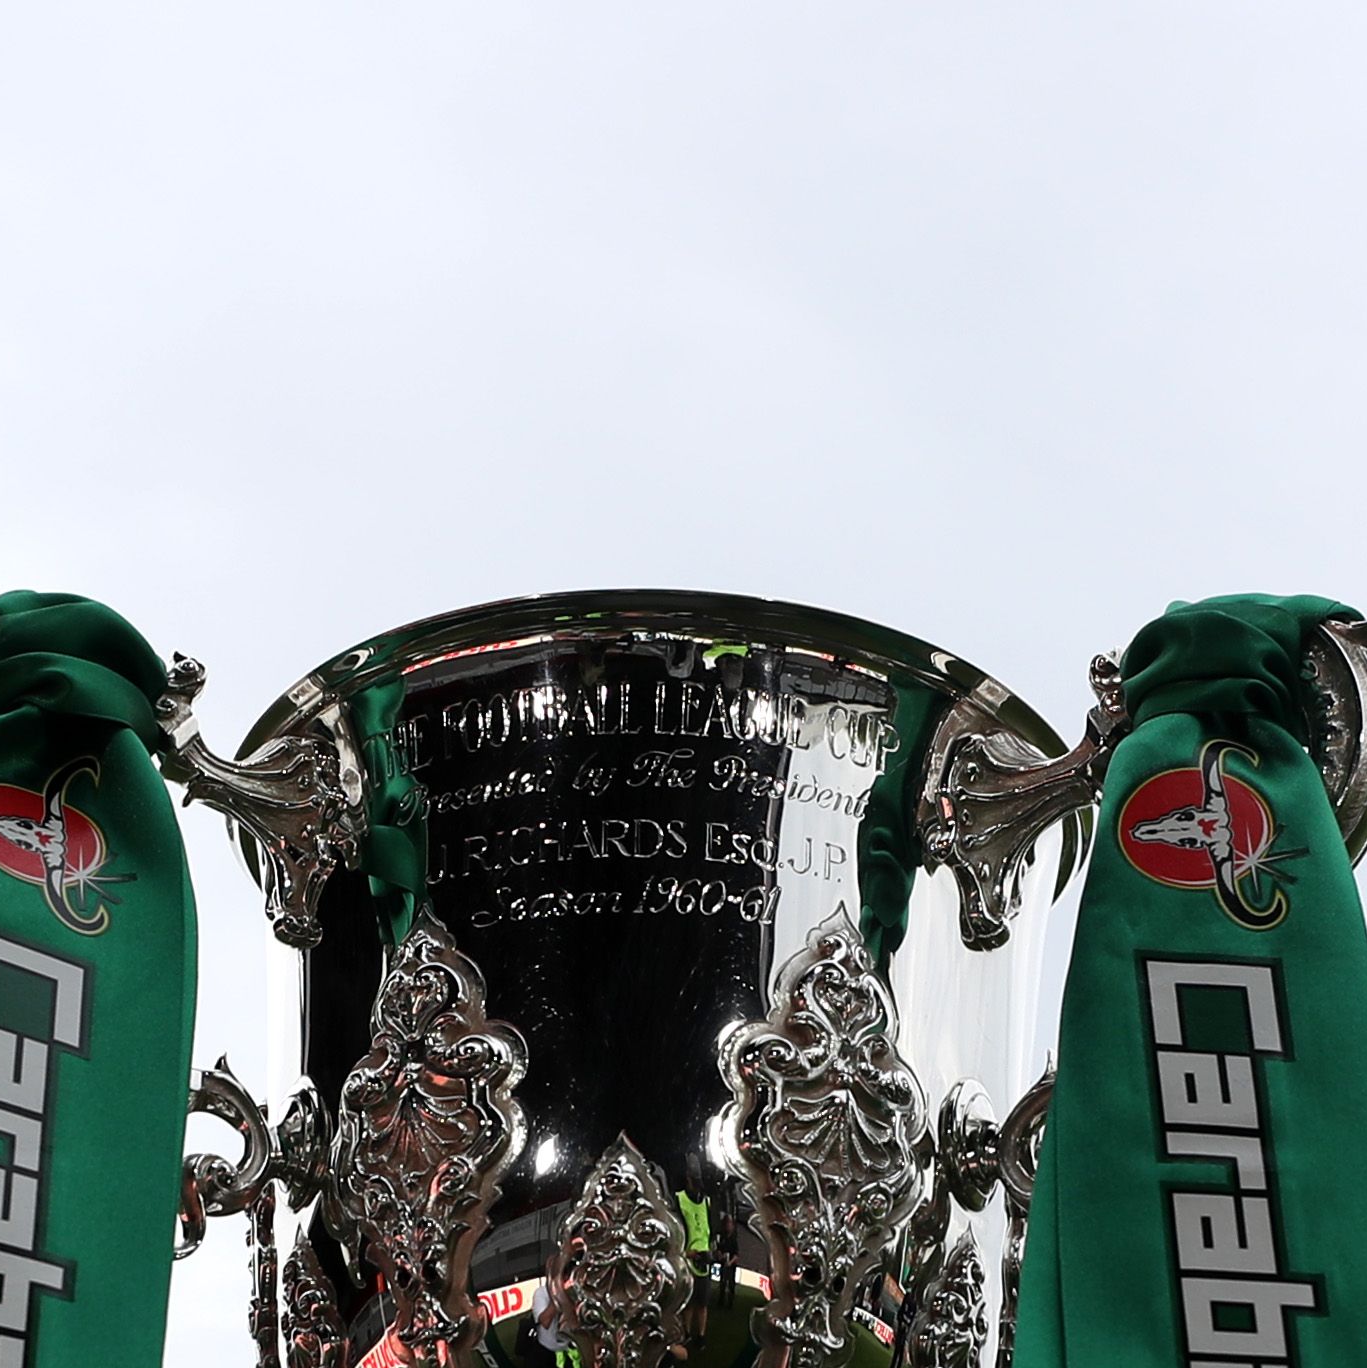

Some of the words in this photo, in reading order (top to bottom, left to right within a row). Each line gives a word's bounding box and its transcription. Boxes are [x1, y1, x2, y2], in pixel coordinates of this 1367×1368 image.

[443, 680, 643, 759] FOOTBALL
[654, 680, 810, 750] LEAGUE
[826, 704, 901, 776] CUP
[397, 755, 556, 826] Presented
[572, 752, 617, 797] by
[626, 747, 697, 788] The
[709, 754, 871, 818] President
[471, 886, 623, 928] Season
[632, 875, 782, 924] 1960-61
